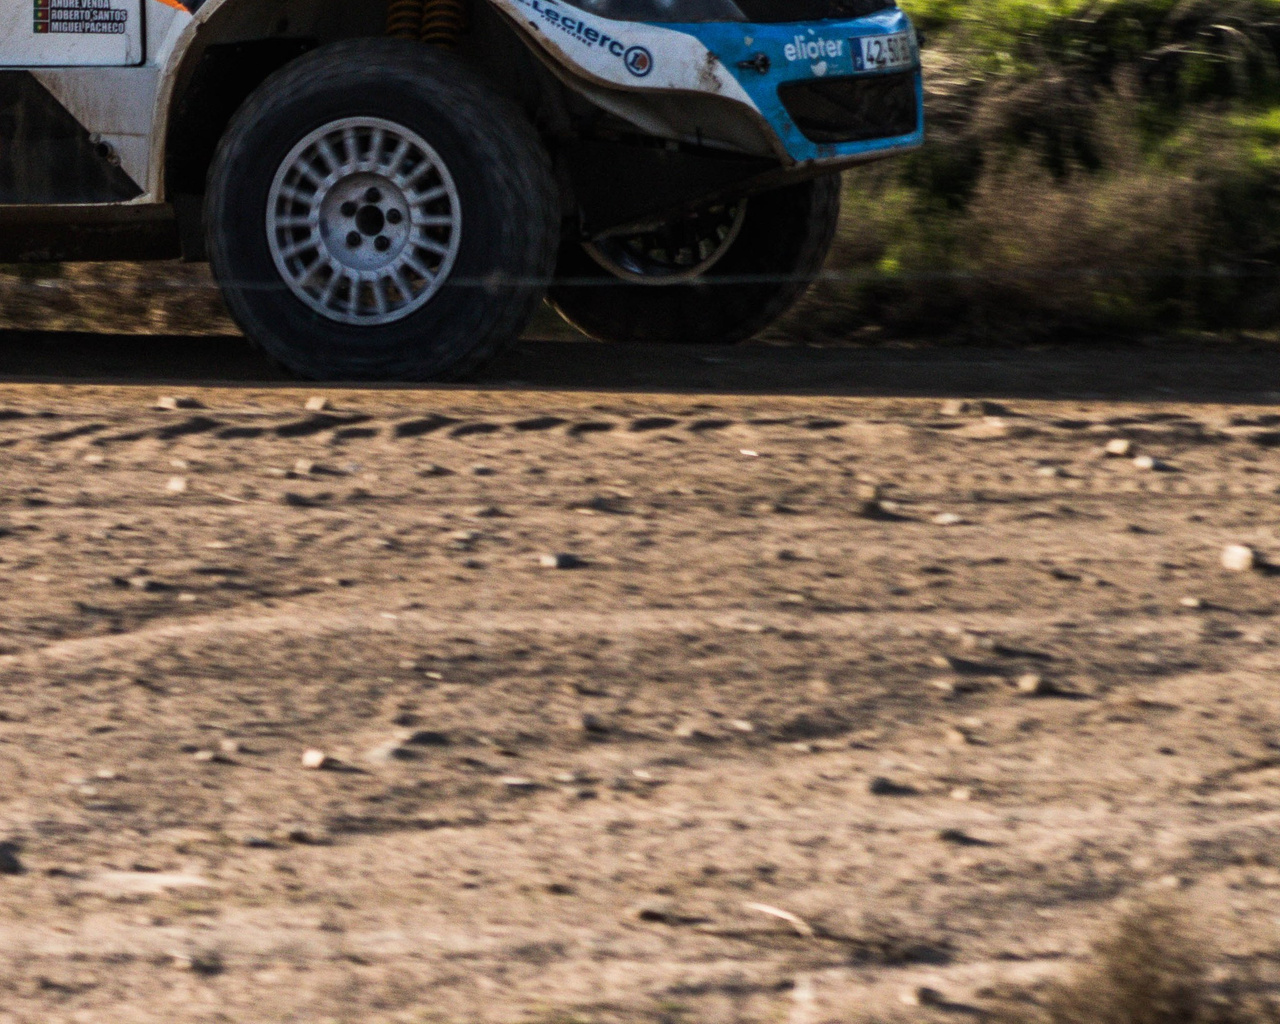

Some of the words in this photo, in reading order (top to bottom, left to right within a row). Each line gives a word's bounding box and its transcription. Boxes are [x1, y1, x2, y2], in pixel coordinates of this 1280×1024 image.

[51, 10, 91, 20] ROBERTO
[93, 10, 126, 21] SANTOS
[51, 22, 83, 32] MIGUEL
[85, 22, 124, 33] PACHECO
